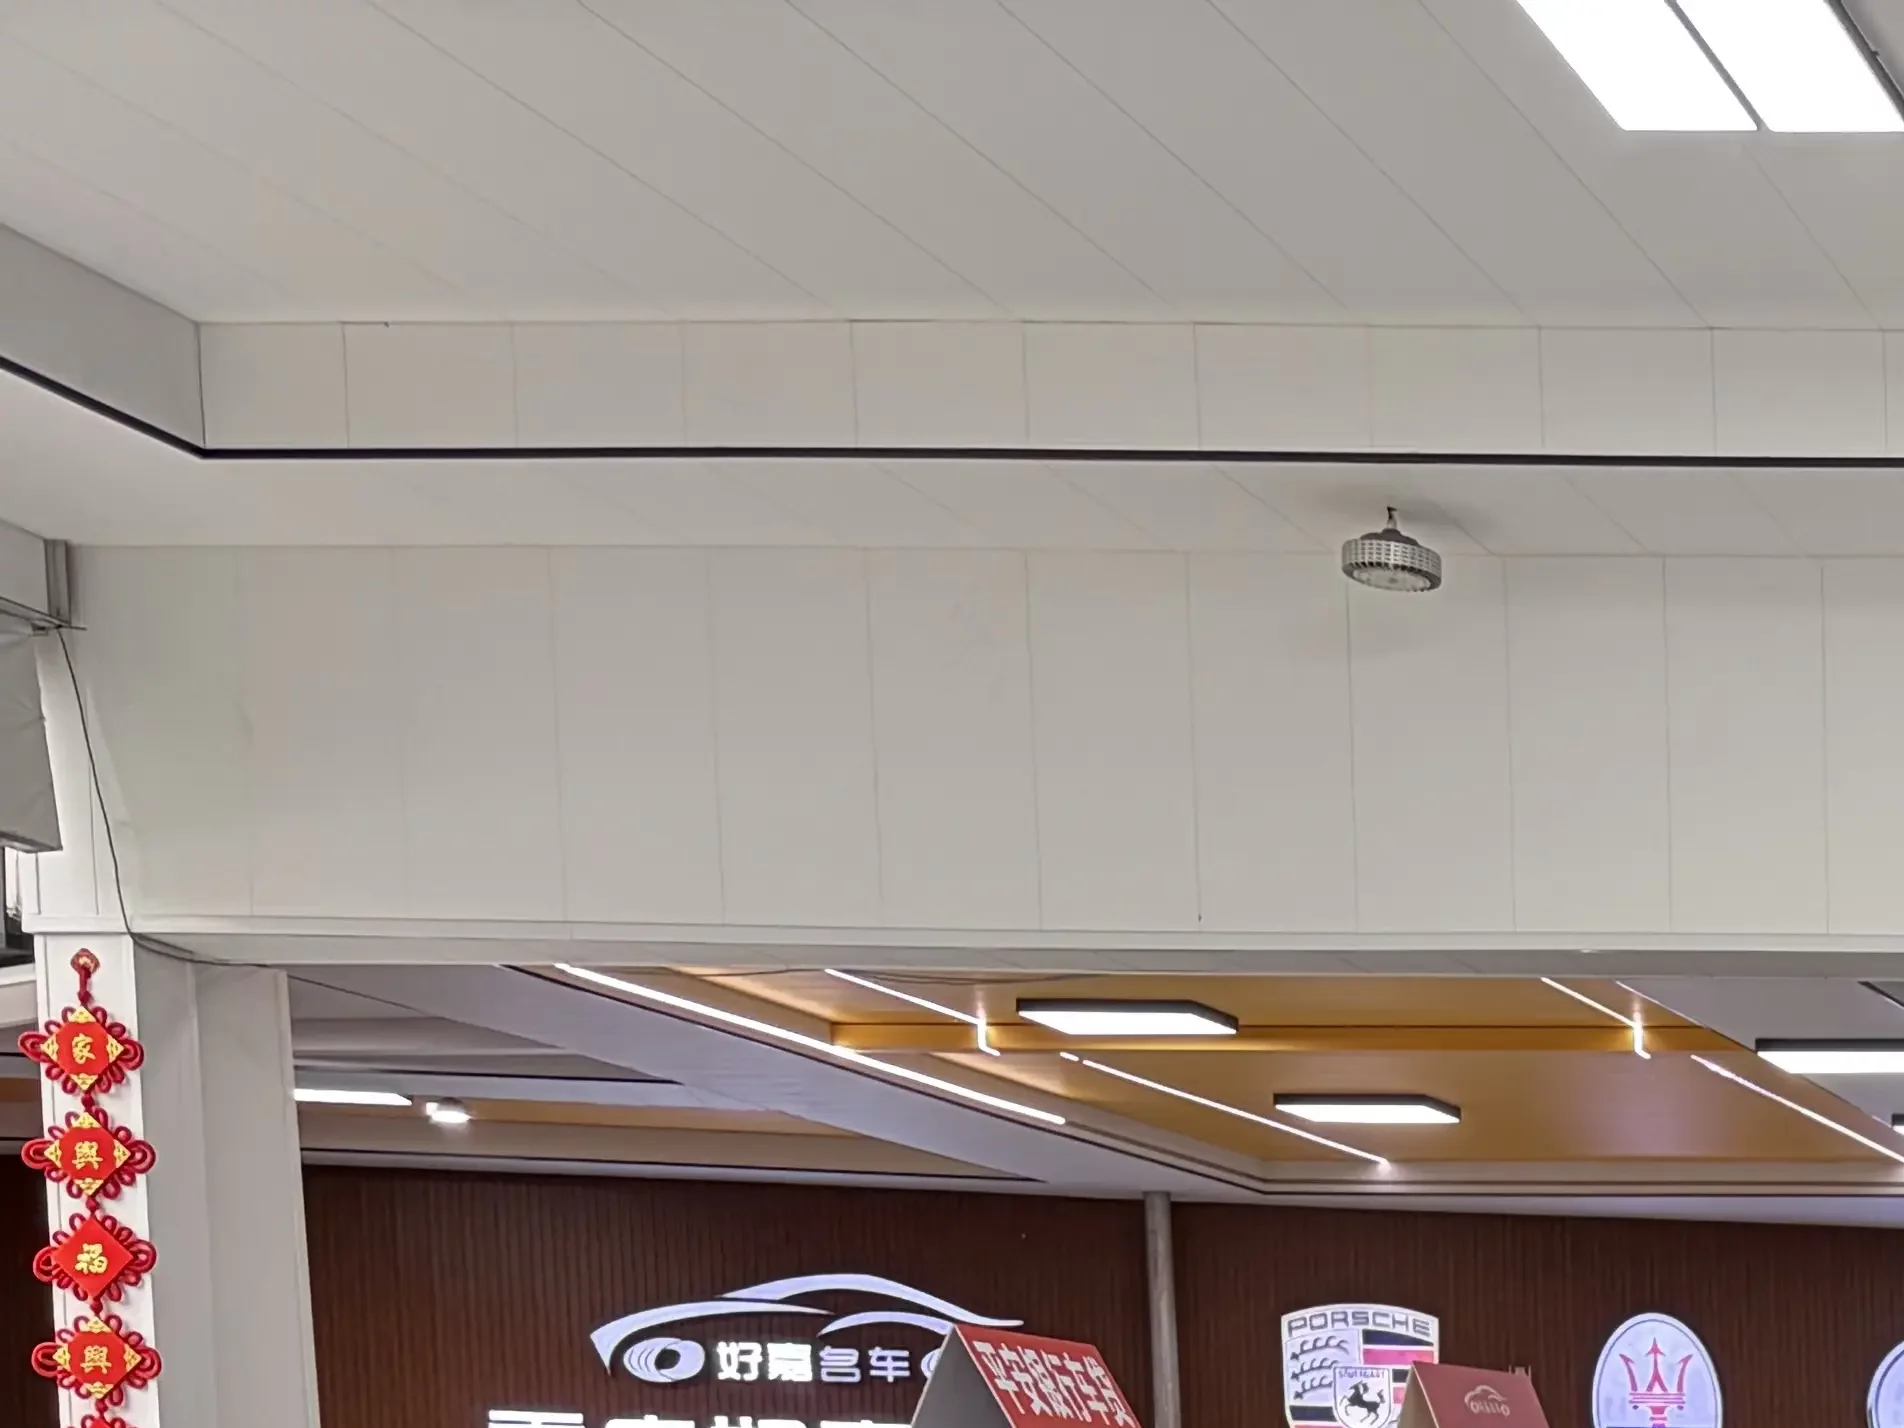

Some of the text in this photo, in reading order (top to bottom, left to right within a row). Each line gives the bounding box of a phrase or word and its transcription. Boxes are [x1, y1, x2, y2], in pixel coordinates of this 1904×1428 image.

[1287, 1310, 1431, 1338] PORSCHE
[716, 1341, 911, 1383] 好嘉名车
